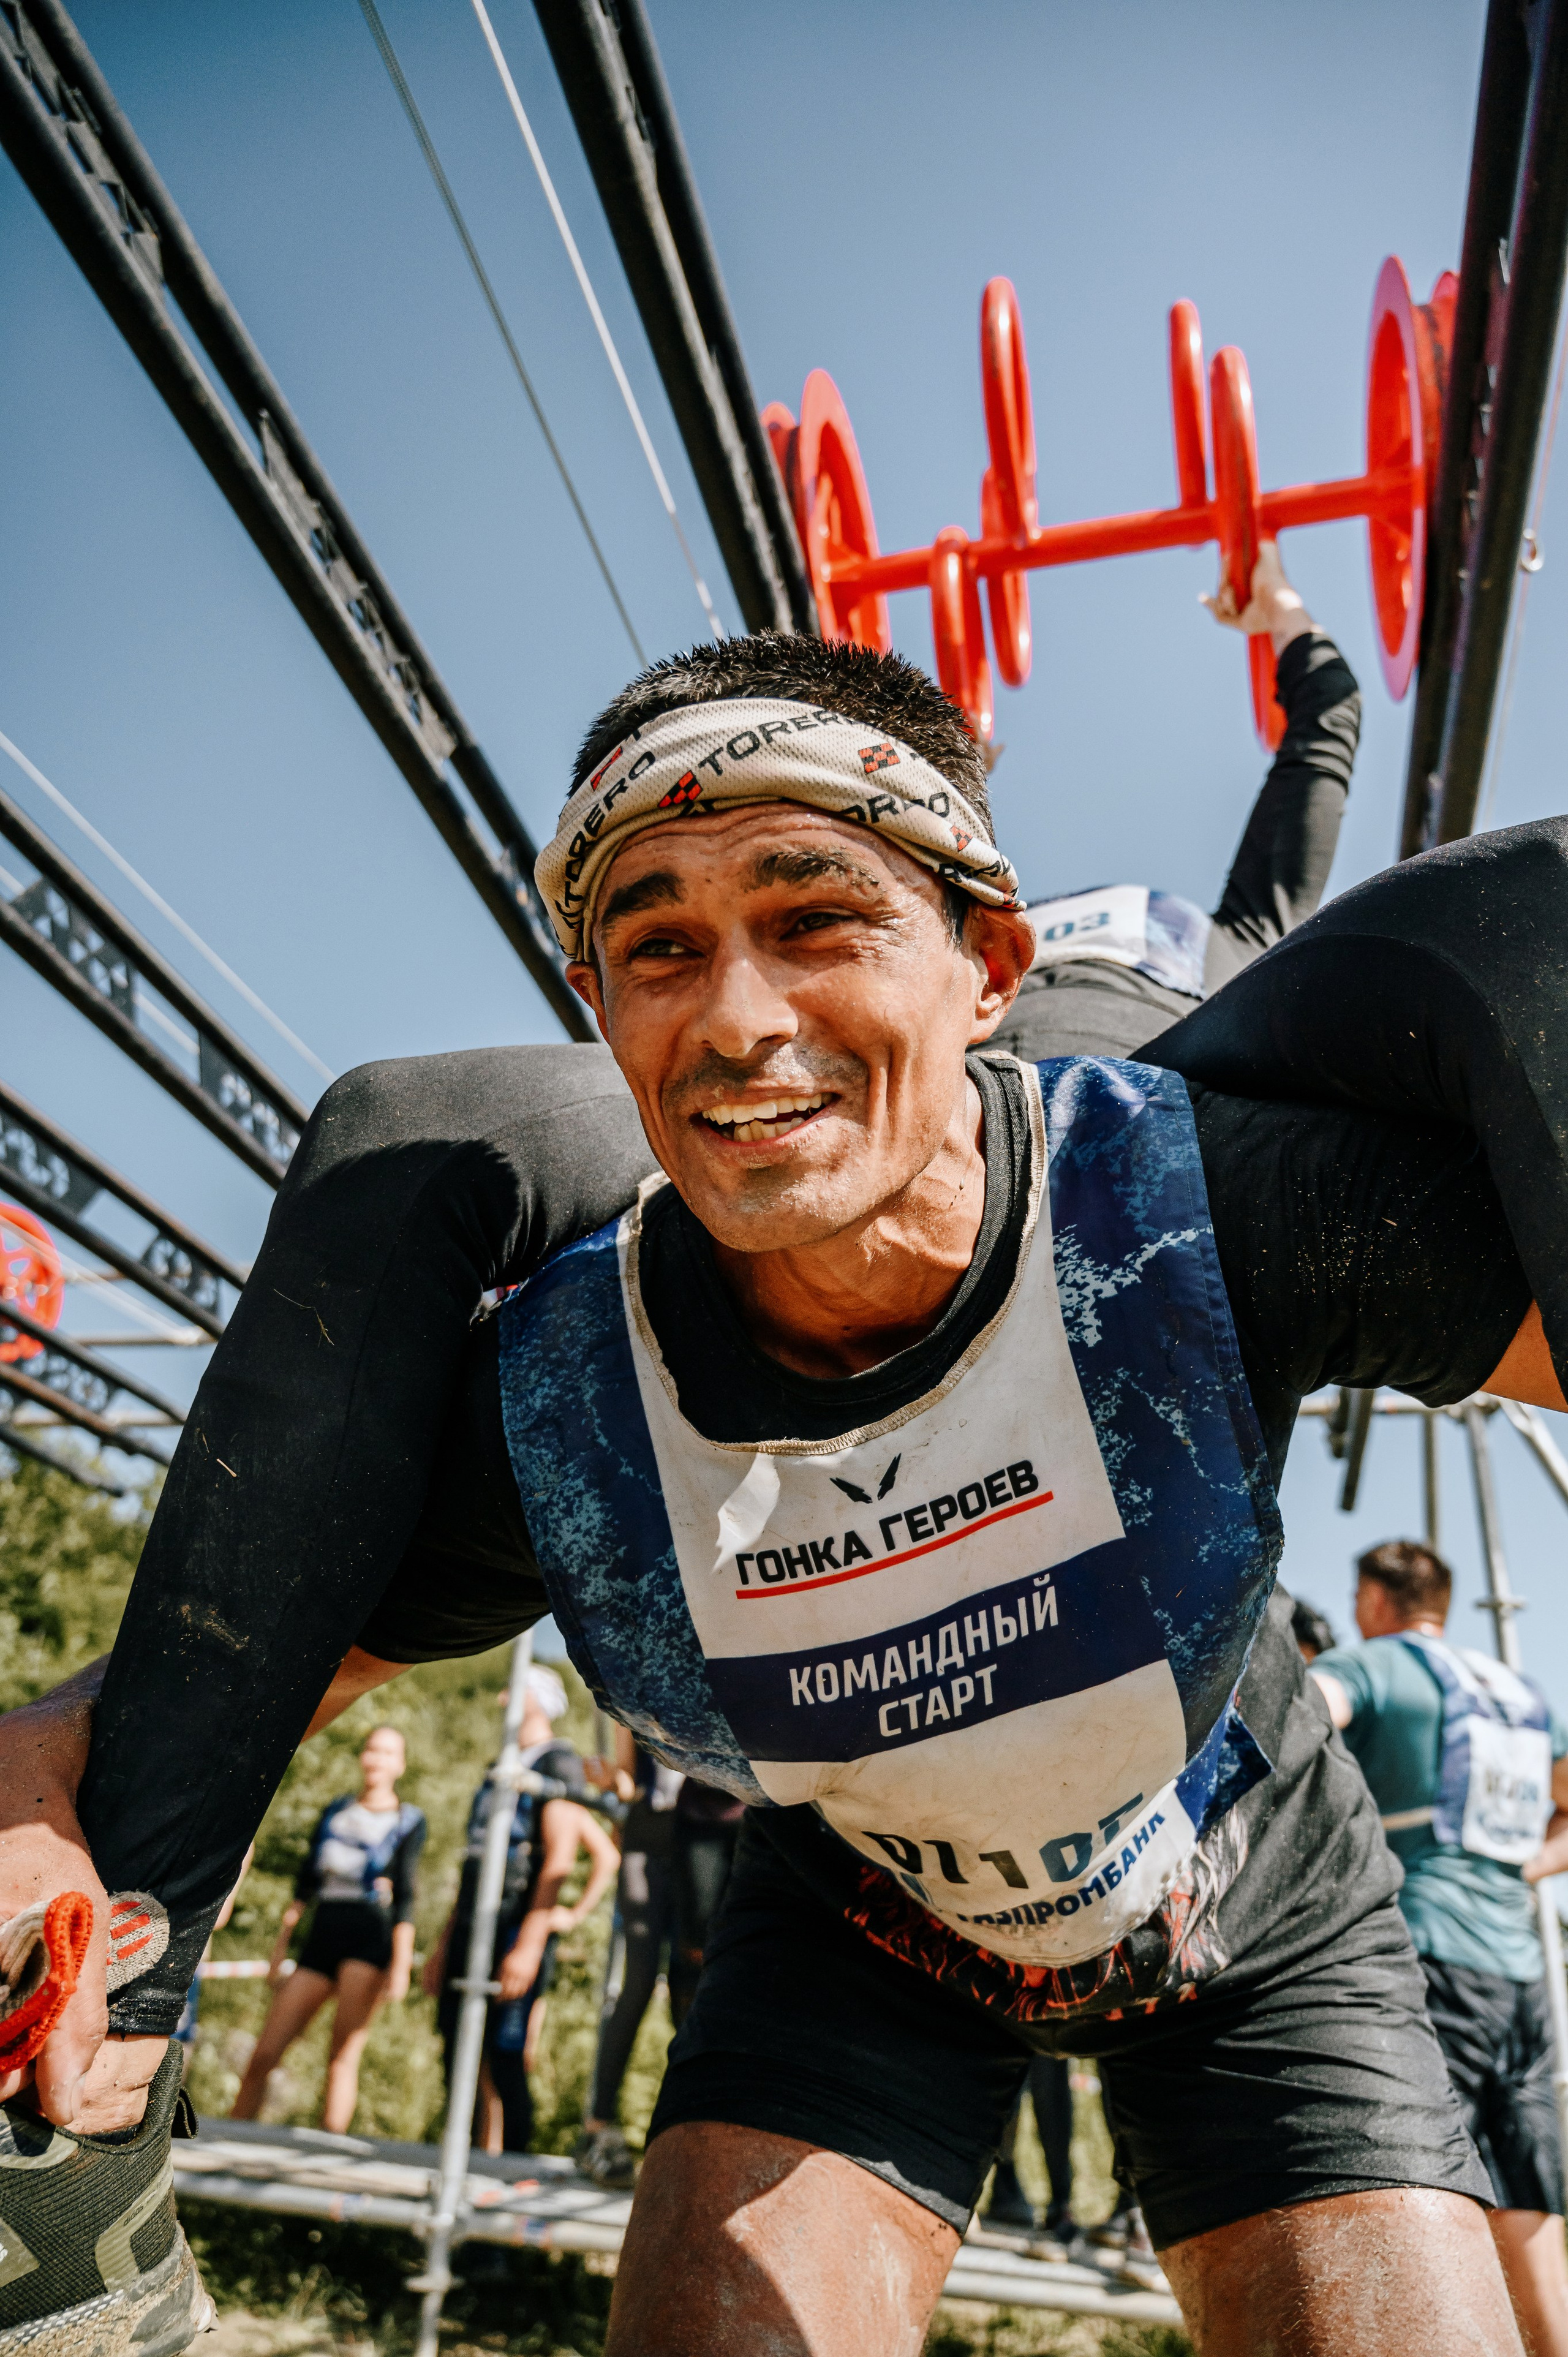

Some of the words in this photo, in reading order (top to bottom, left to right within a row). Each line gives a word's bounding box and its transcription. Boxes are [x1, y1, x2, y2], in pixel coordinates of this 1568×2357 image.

[698, 709, 853, 776] TORER
[565, 751, 656, 908] TORERO
[735, 1530, 873, 1585] ГОНКА
[878, 1459, 1039, 1552] ГЕРОЕВ
[789, 1574, 1058, 1706] КОМАНДНЫЙ
[878, 1664, 998, 1737] СТАРТ
